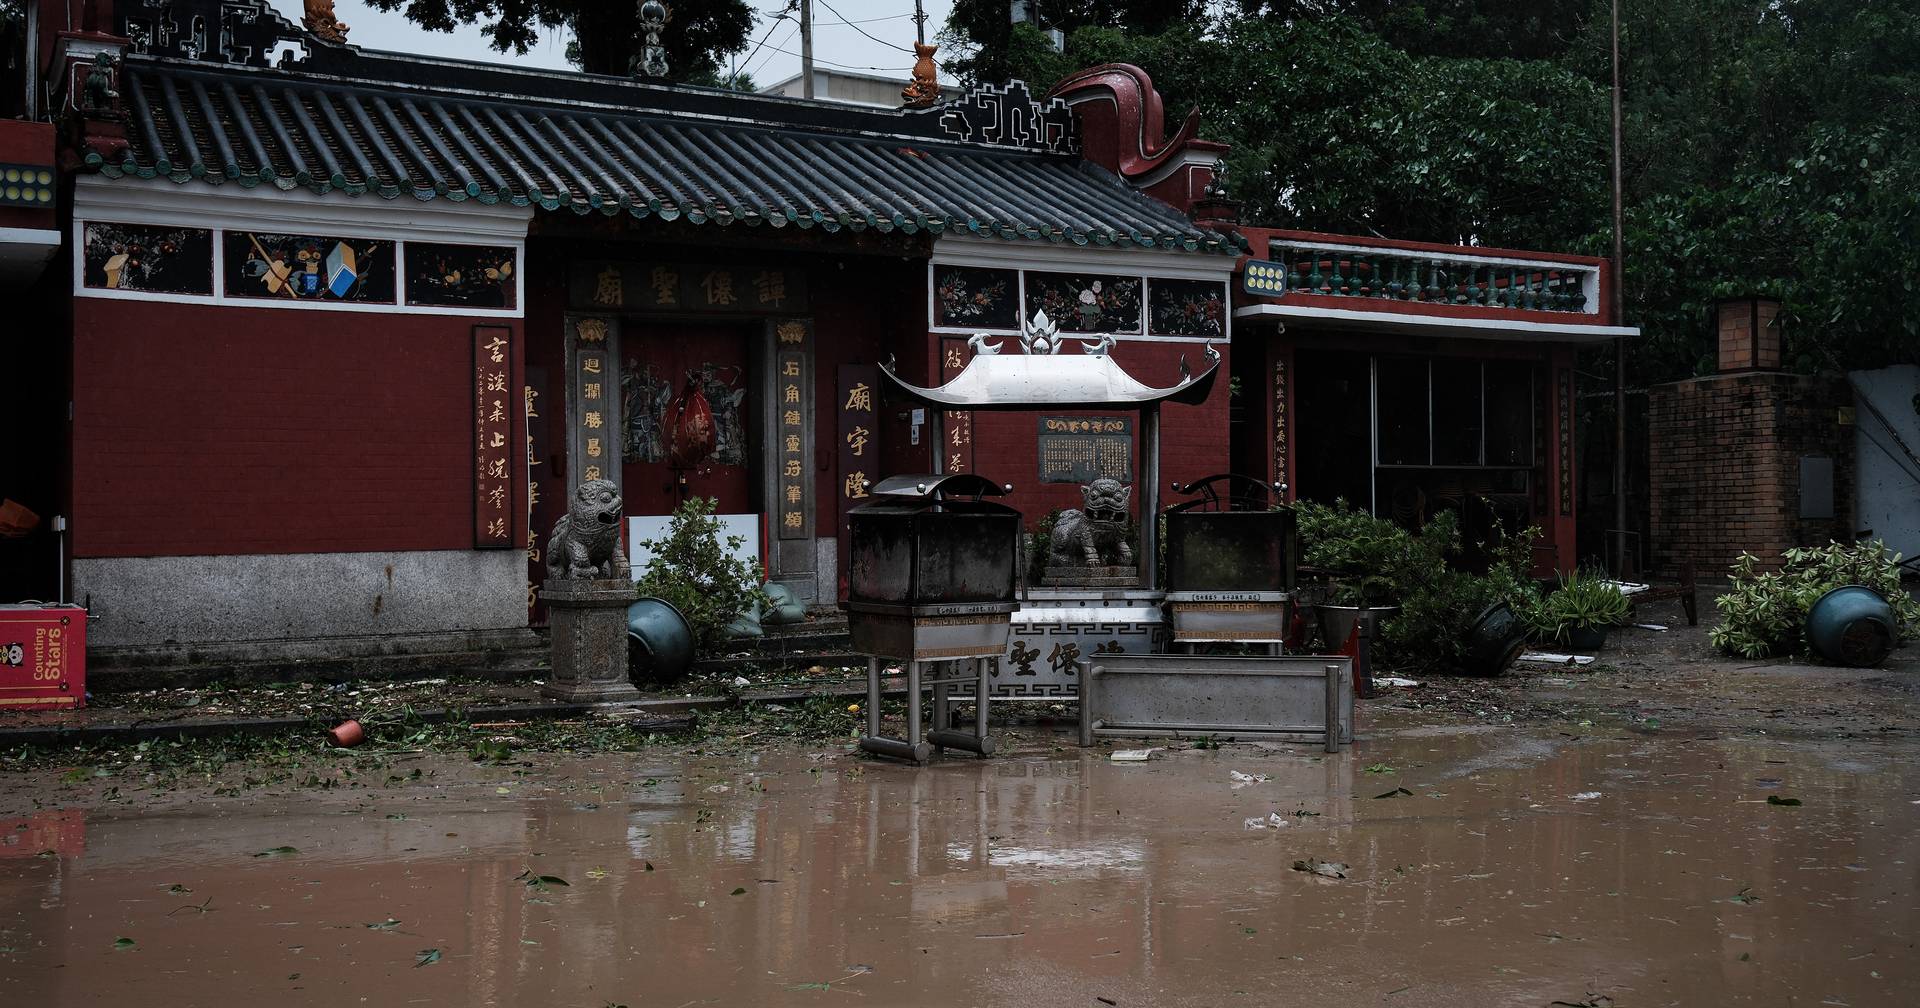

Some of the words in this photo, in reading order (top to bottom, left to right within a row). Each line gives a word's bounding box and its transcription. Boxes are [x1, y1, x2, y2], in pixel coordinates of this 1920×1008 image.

[844, 382, 872, 499] 廟宇隆
[33, 627, 47, 681] Counting
[45, 627, 62, 681] Stars
